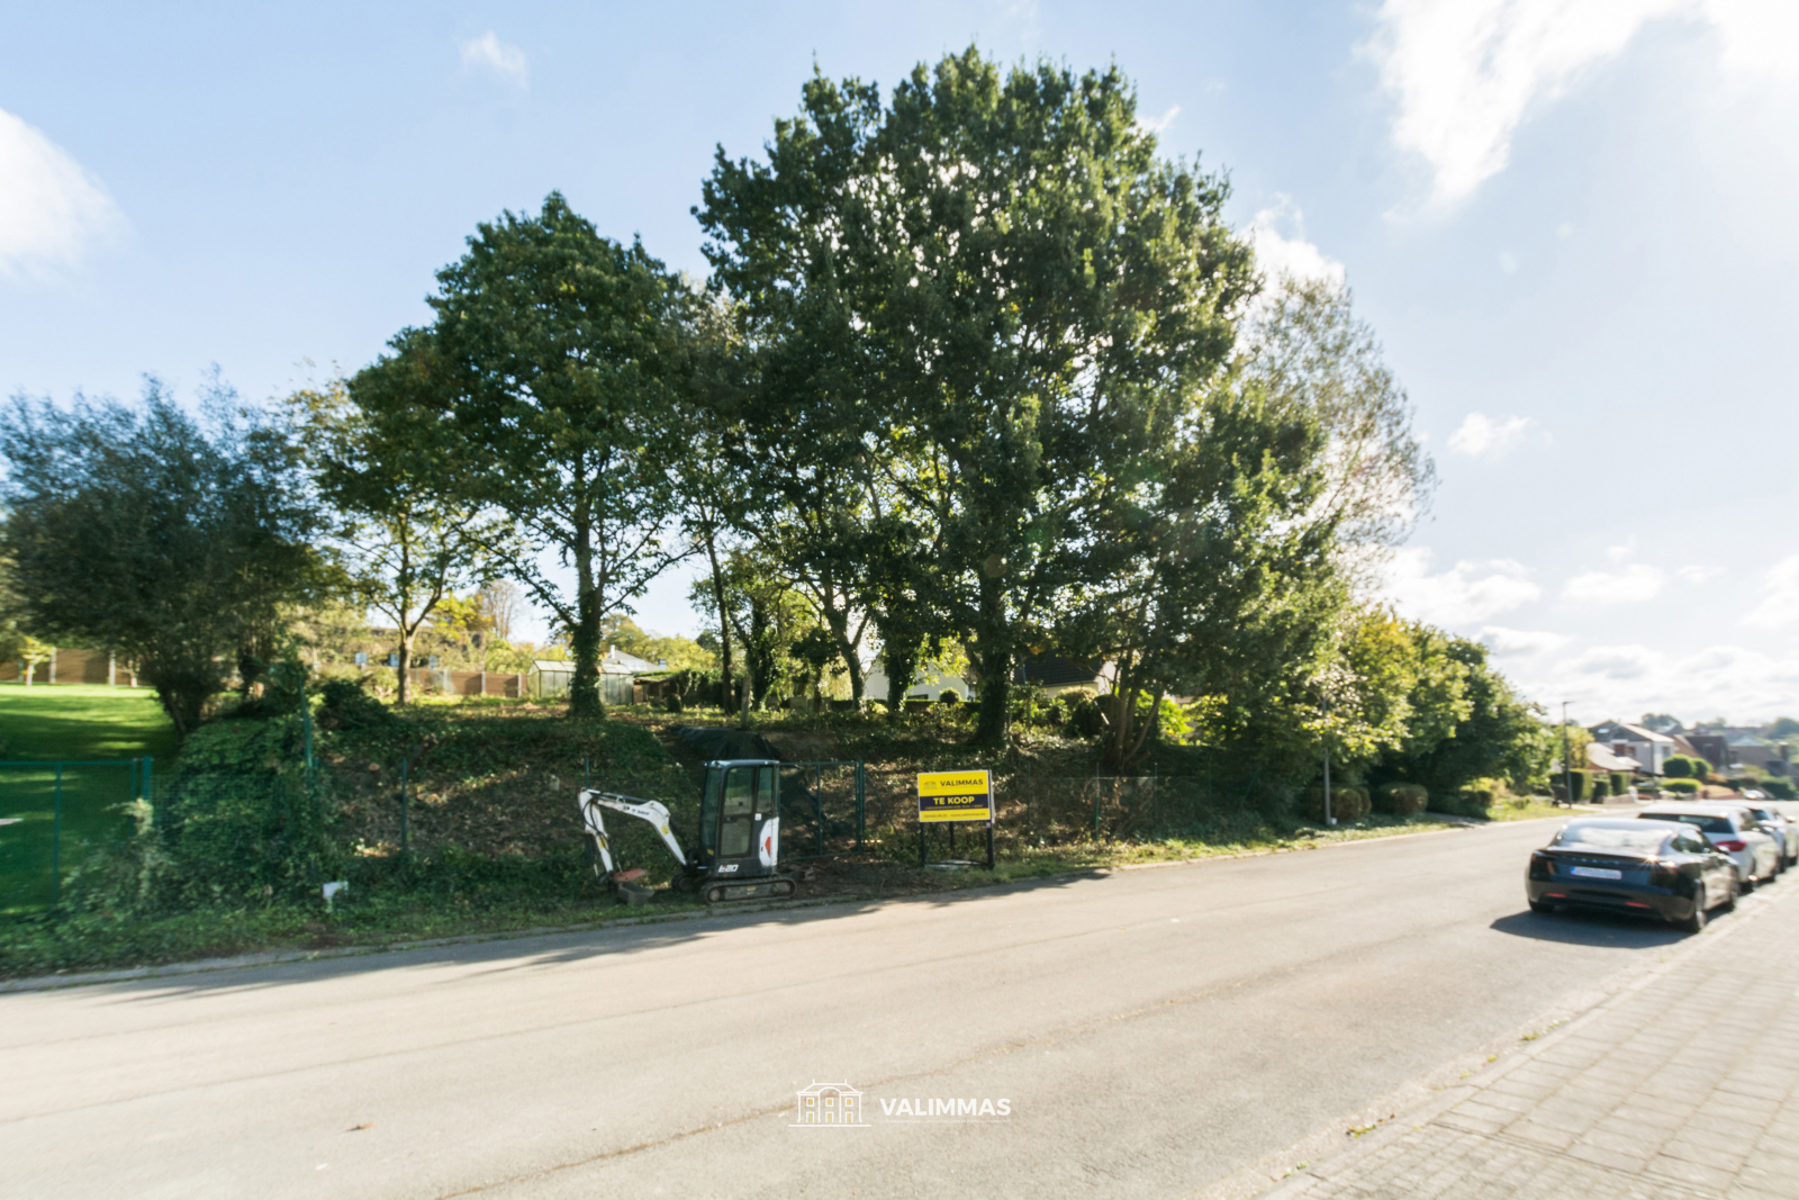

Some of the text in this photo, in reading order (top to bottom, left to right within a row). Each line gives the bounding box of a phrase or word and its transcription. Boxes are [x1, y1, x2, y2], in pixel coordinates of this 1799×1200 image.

[940, 779, 983, 787] VALIMMAS
[933, 796, 975, 805] TE KOOP
